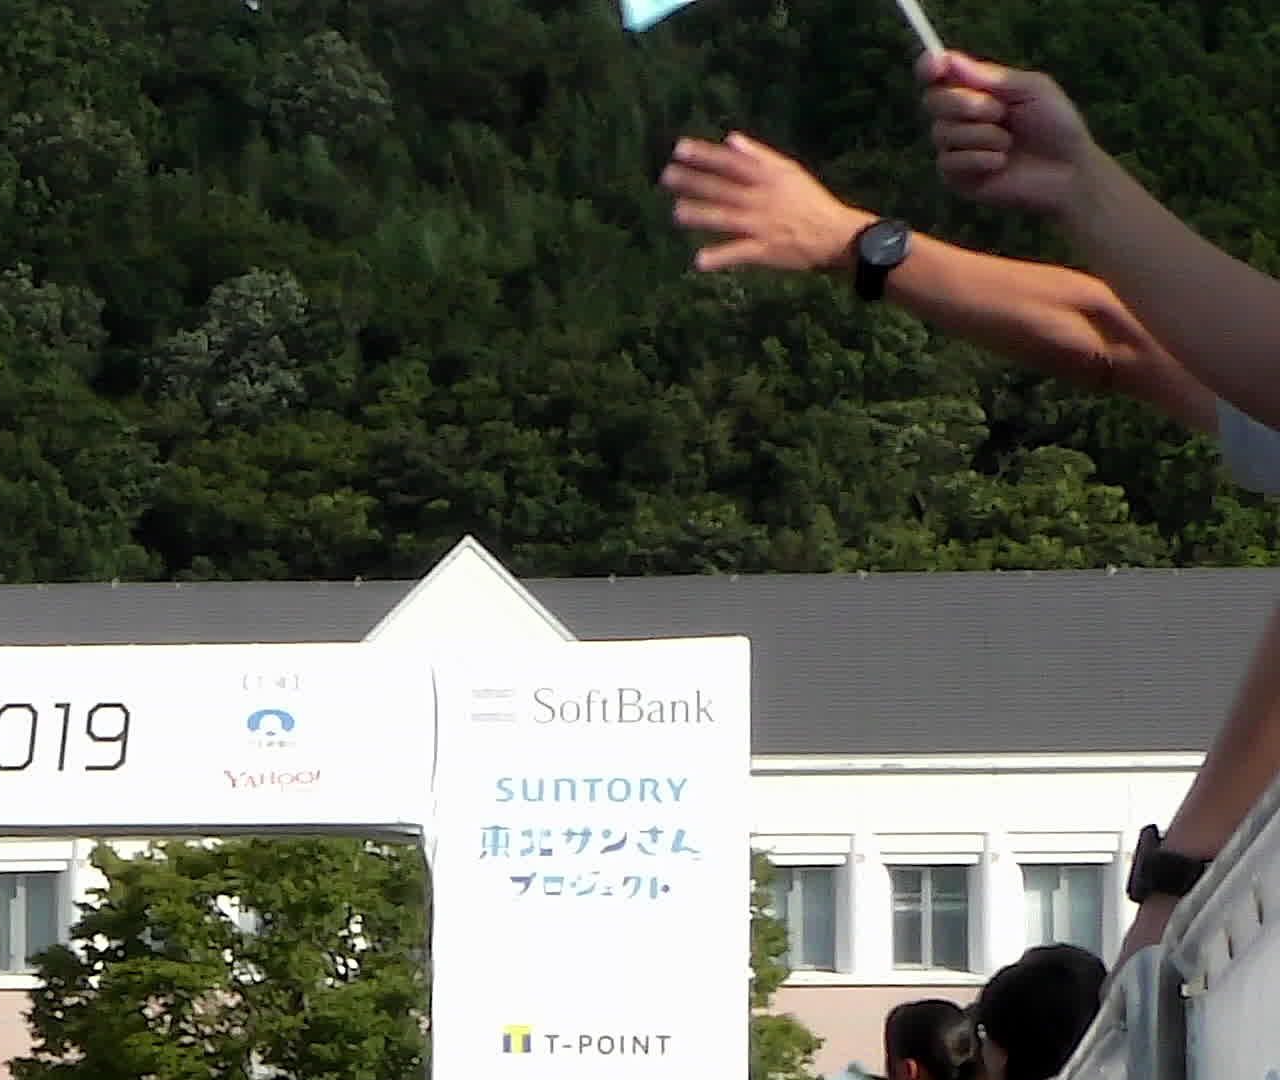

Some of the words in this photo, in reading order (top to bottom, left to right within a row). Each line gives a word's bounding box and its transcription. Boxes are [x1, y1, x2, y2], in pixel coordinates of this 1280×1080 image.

[533, 687, 716, 724] SoftBank
[495, 776, 688, 803] SUNTORY
[543, 1033, 673, 1055] T-POINT
